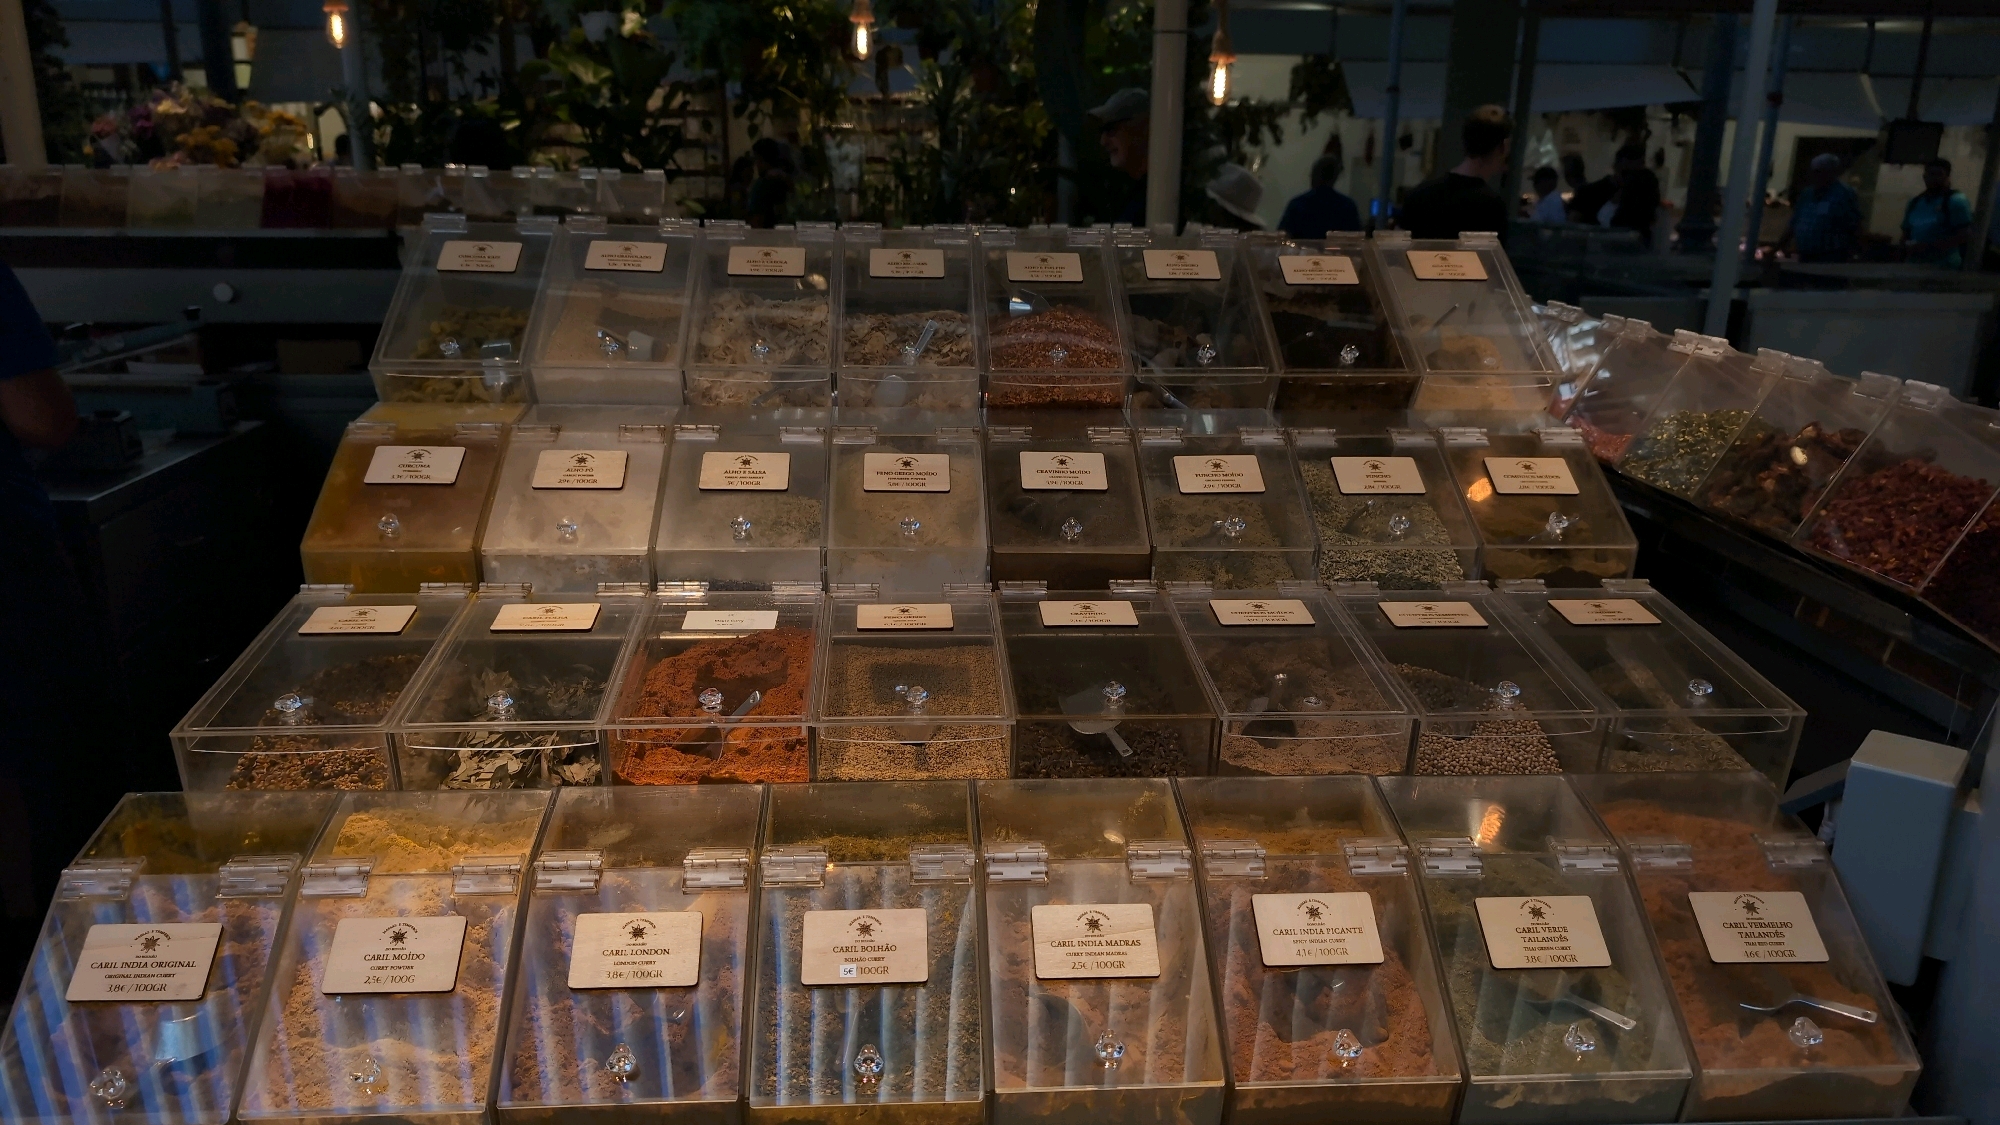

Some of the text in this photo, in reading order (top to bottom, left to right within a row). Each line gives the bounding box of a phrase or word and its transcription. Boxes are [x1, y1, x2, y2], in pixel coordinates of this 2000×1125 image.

[1515, 925, 1569, 934] CARIL VERDE
[1747, 921, 1793, 929] VERMELHO
[1272, 928, 1298, 936] CARIL
[1299, 927, 1325, 935] INDIA
[1737, 929, 1786, 939] TAILANDÊS
[1520, 933, 1569, 943] TAILANDÊS
[860, 943, 897, 953] BOLHÃO
[1050, 940, 1076, 948] CARIL
[1105, 939, 1141, 947] MADRAS
[363, 951, 426, 961] CARIL MOÍDO
[602, 948, 670, 957] CARIL LONDON
[1319, 947, 1349, 957] 100GR
[1766, 949, 1797, 958] 100GR
[1548, 954, 1579, 963] 100GR
[90, 960, 197, 969] CARIL INDIA ORIGINAL
[1095, 960, 1126, 969] 100GR
[631, 969, 663, 979] 100GR
[843, 967, 855, 976] 5€
[390, 974, 416, 984] 100G
[135, 983, 167, 992] 100GR
